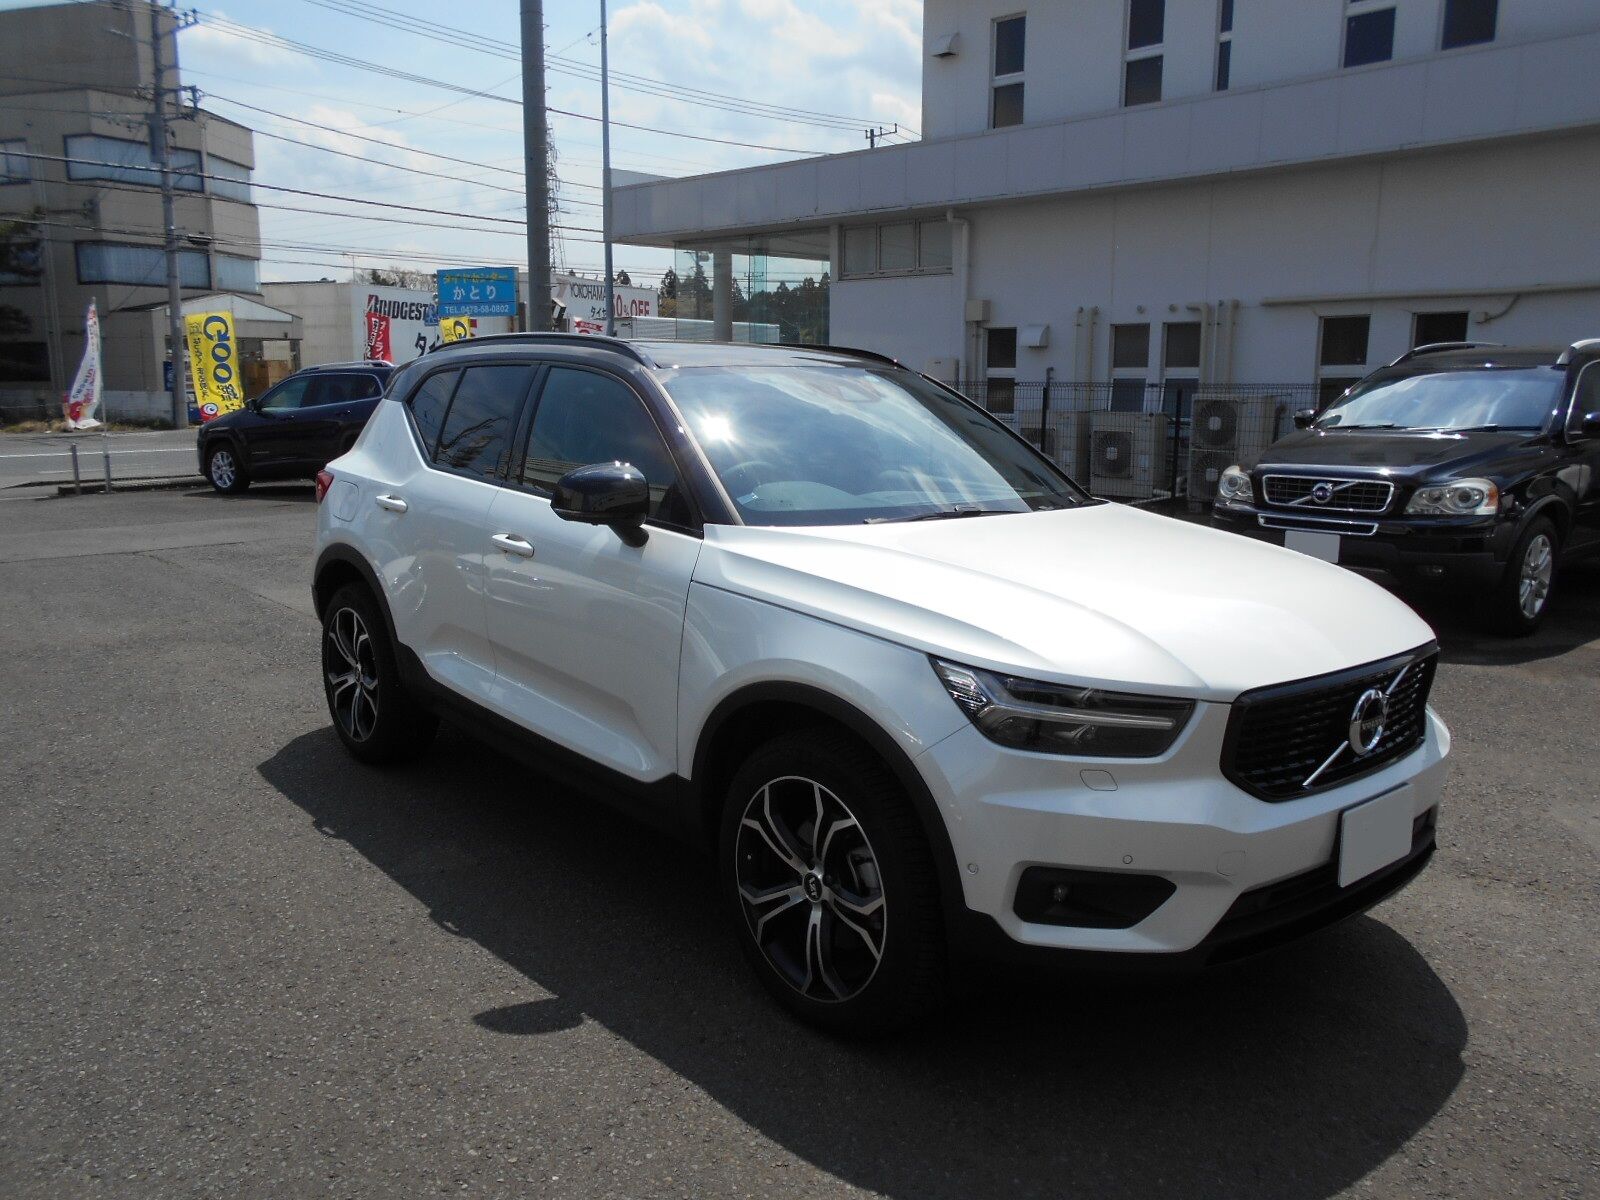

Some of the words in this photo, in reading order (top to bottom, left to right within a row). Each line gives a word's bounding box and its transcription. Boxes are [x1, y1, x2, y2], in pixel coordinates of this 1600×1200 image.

[453, 285, 497, 301] かとり
[367, 294, 429, 321] BRIDGEST
